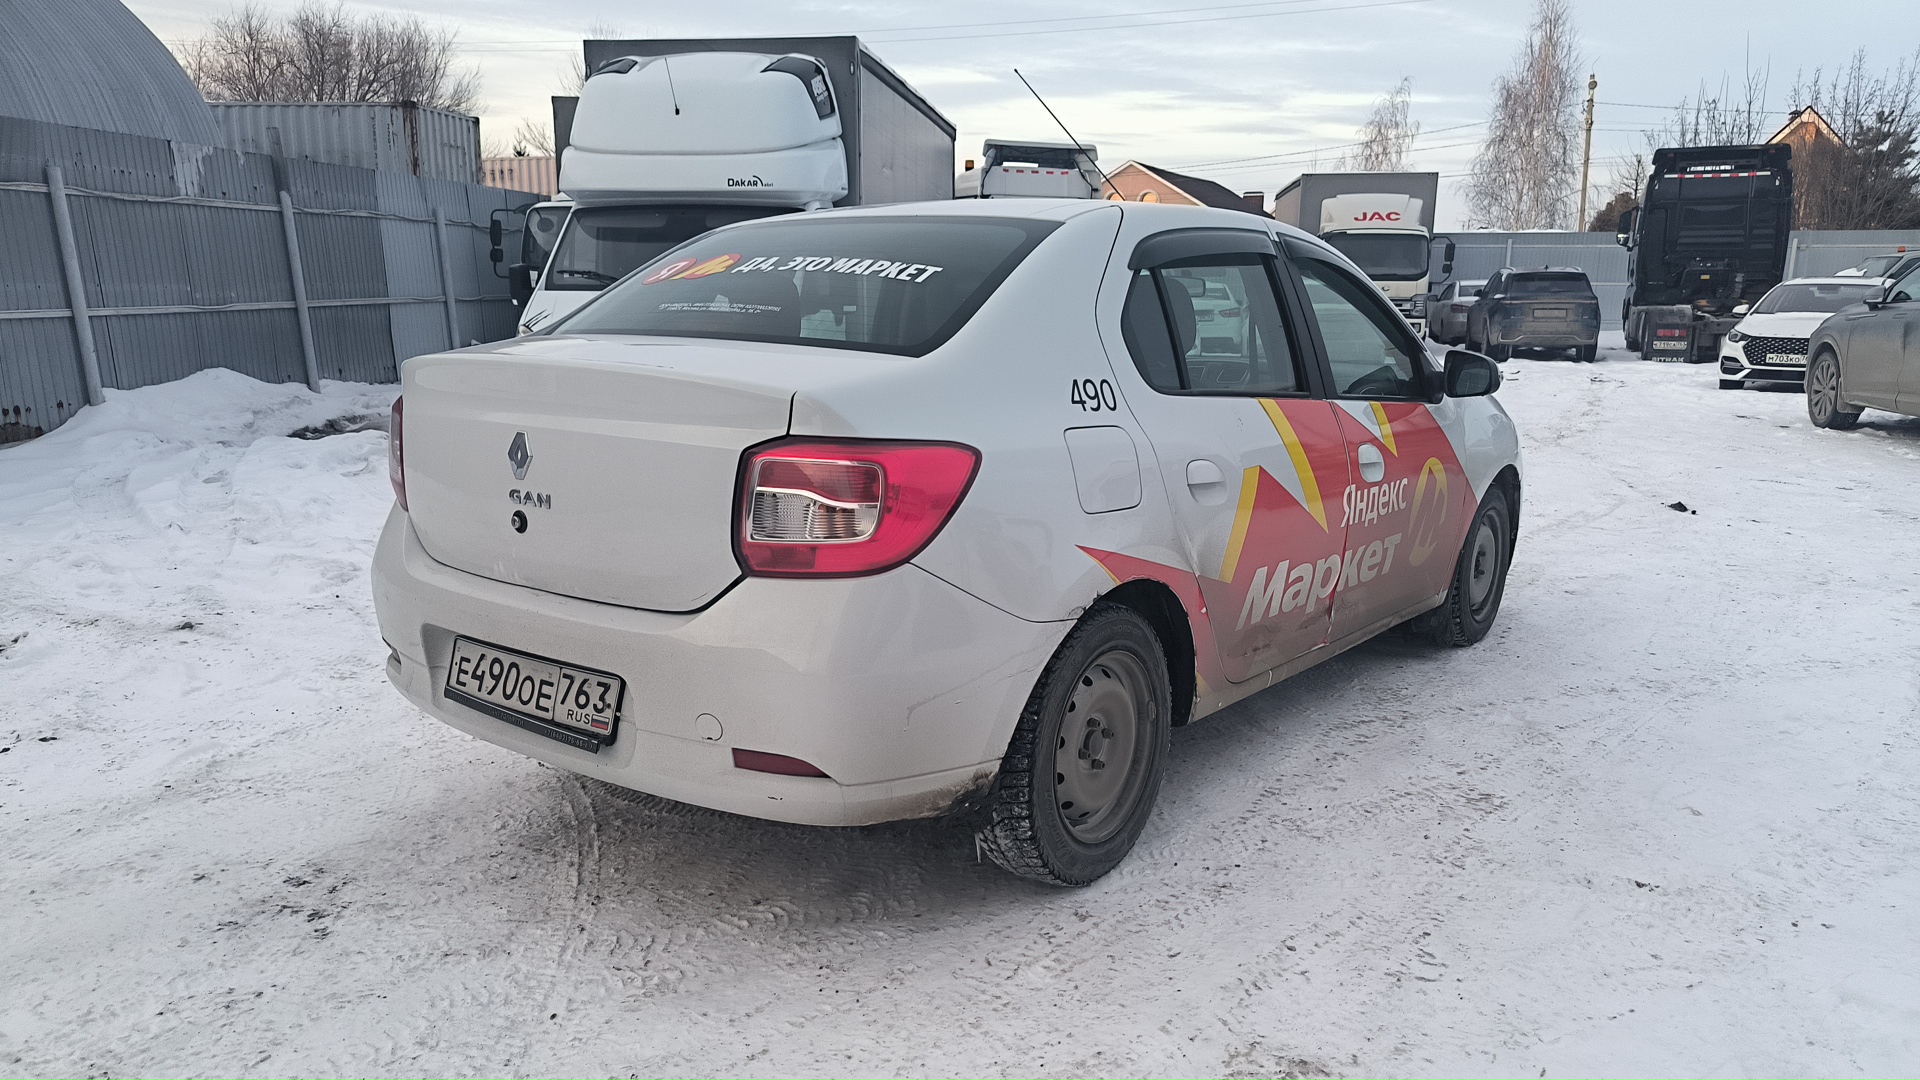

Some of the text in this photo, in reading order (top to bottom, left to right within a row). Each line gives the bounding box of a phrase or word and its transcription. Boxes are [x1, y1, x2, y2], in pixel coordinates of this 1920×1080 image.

[727, 178, 759, 187] DAKAR
[1353, 211, 1401, 222] JAC
[731, 256, 780, 274] ДА,
[777, 256, 833, 272] ЭТО
[824, 257, 944, 283] МАРКЕТ
[1071, 378, 1117, 412] 490
[508, 489, 552, 509] GAN
[1340, 477, 1408, 528] Яндекс
[1234, 532, 1403, 632] Маркет
[455, 653, 612, 715] Е490ОЕ 763
[567, 708, 590, 726] RUS
